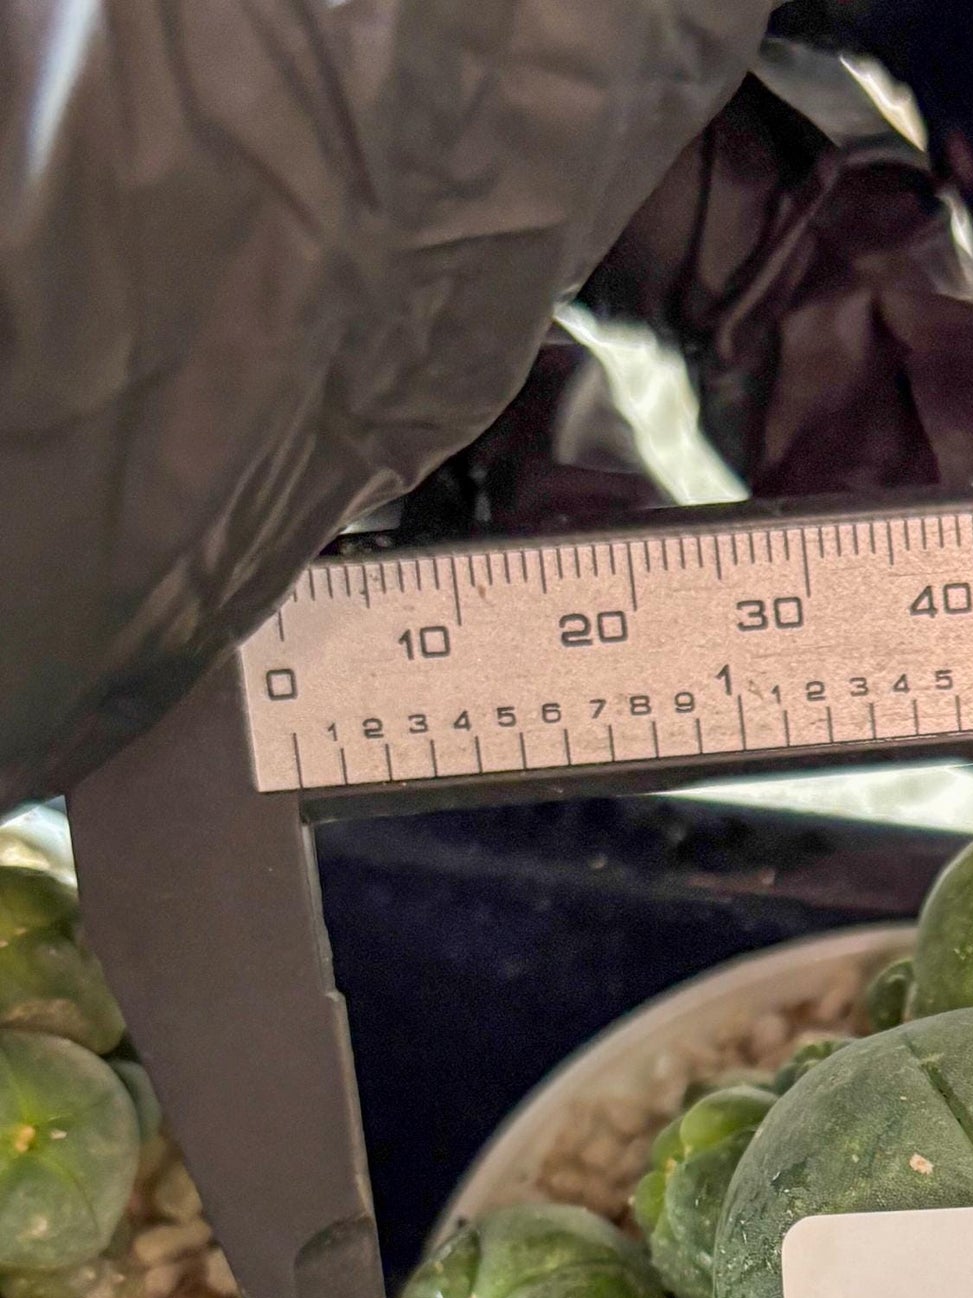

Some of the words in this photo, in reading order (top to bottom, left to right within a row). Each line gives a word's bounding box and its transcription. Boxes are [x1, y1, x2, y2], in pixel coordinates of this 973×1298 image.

[266, 668, 297, 701] 0
[398, 625, 452, 661] 10
[558, 610, 629, 647] 20
[736, 596, 804, 631] 30
[909, 582, 973, 618] 40
[326, 722, 339, 742] 1
[362, 718, 384, 739] 2
[408, 714, 429, 734] 3
[453, 711, 473, 732] 4
[497, 706, 517, 727] 5
[541, 703, 562, 723] 6
[588, 699, 607, 720] 7
[629, 695, 651, 716] 8
[674, 691, 696, 714] 9
[715, 664, 732, 696] 1
[770, 685, 782, 705] 1
[806, 681, 826, 701] 2
[850, 676, 870, 697] 3
[893, 673, 911, 694] 4
[935, 669, 953, 690] 5
